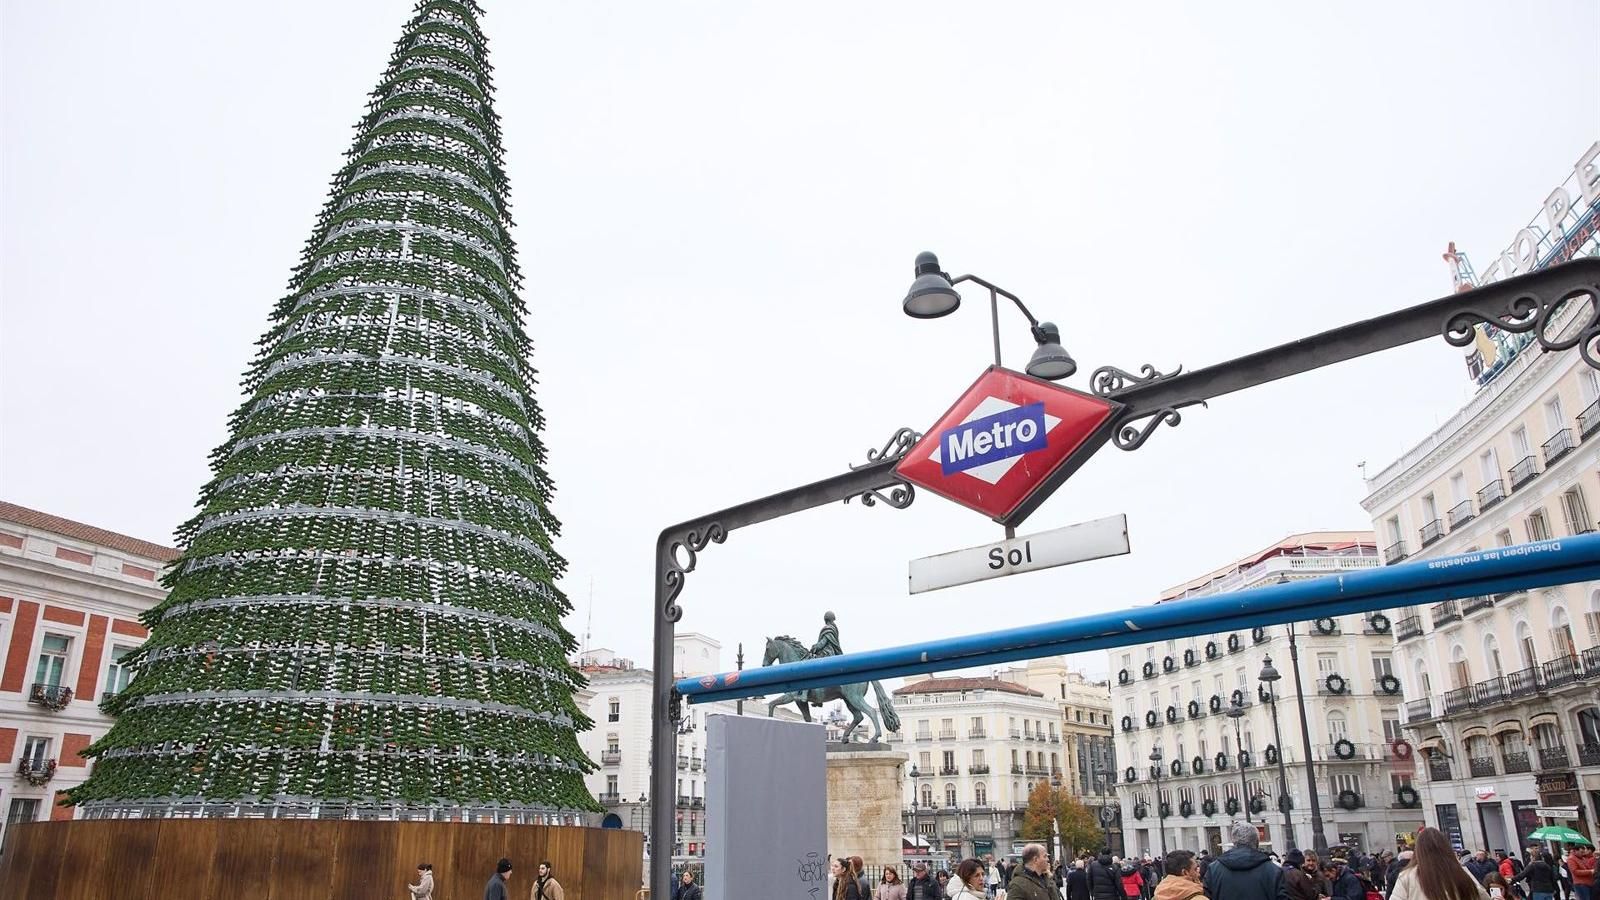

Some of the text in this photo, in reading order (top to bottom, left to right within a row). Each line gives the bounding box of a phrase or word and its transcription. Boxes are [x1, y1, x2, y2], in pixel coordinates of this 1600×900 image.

[948, 419, 1038, 463] Metro
[988, 540, 1032, 570] Sol
[1428, 541, 1561, 569] Disculpen las molestias
